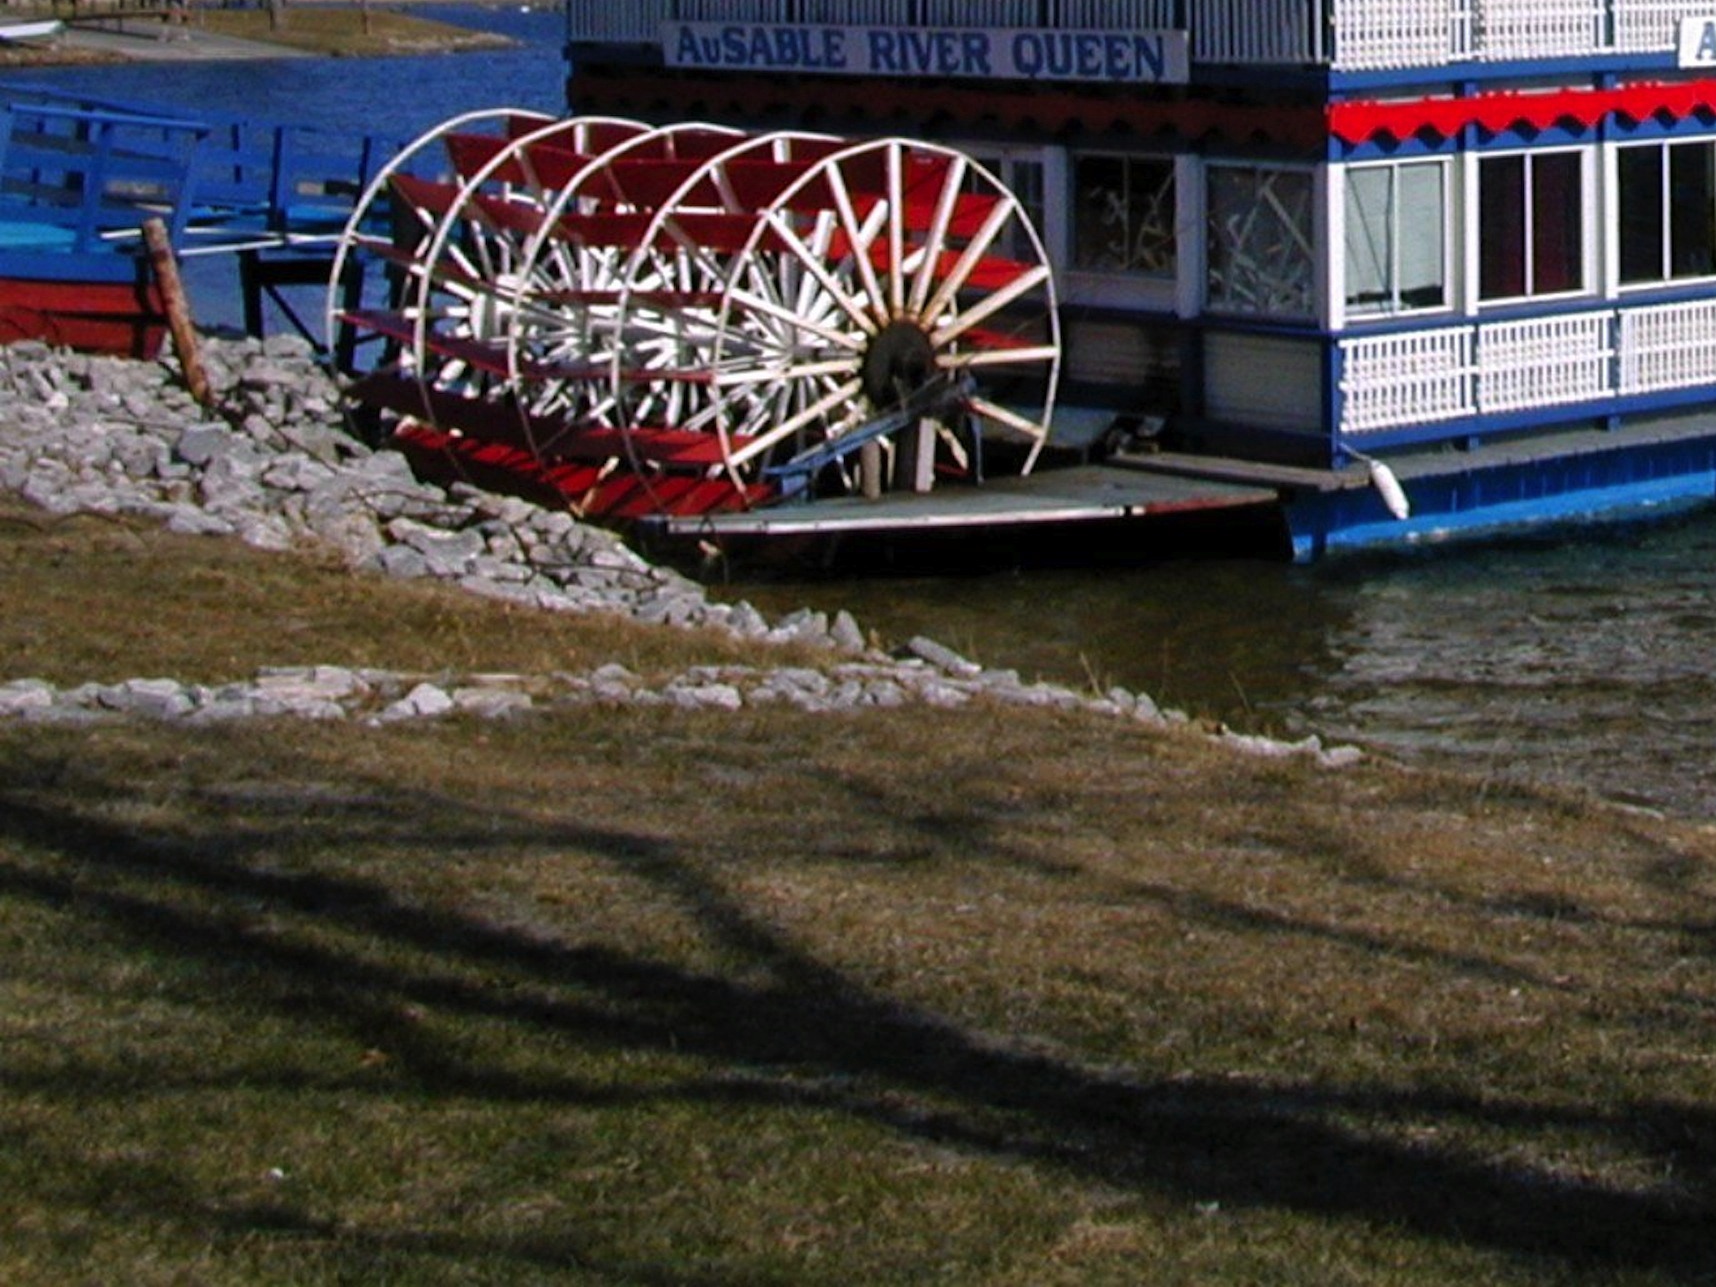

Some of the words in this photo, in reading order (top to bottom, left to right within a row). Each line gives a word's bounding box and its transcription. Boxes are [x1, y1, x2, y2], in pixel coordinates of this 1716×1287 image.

[676, 26, 847, 68] AuSABLE
[868, 31, 992, 74] RIVER
[1012, 33, 1166, 80] QUEEN
